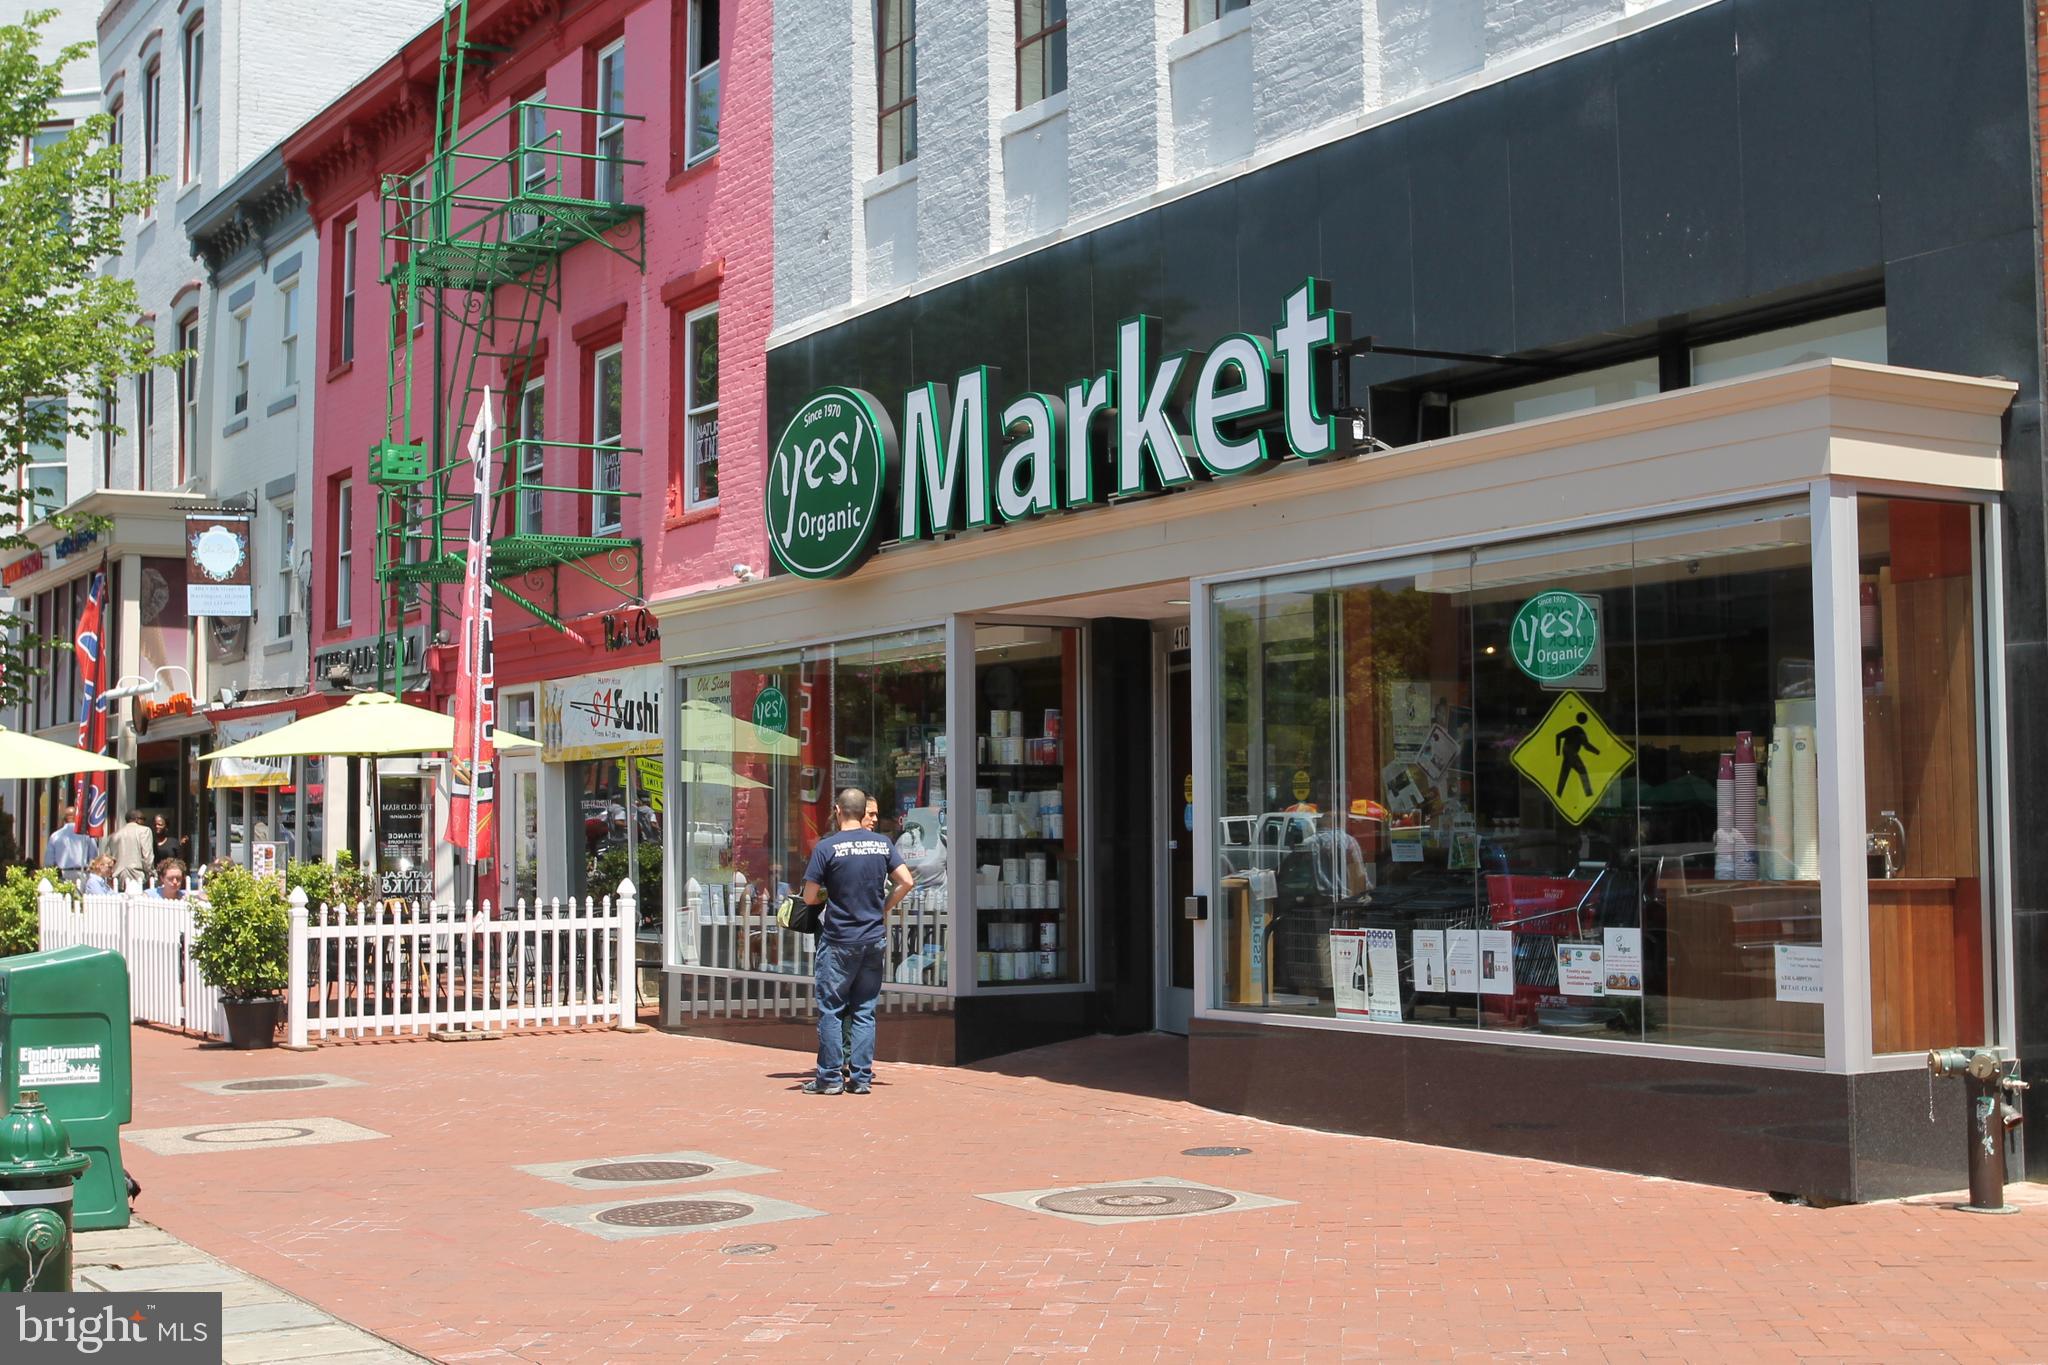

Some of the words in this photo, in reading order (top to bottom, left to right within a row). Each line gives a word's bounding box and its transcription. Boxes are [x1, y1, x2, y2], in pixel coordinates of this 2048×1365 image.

[804, 408, 822, 428] Since
[823, 403, 841, 419] 1970
[899, 276, 1338, 541] Market
[697, 435, 719, 465] KIN
[798, 502, 861, 542] Organic
[1537, 598, 1552, 608] Since
[1552, 596, 1567, 605] 1970
[1174, 626, 1189, 649] 410
[1537, 646, 1584, 665] Organic
[613, 688, 659, 734] Sushi
[832, 841, 855, 850] THINK
[834, 849, 850, 858] ACT
[851, 847, 890, 856] PRACTICALLY
[19, 1044, 101, 1062] Employment
[29, 1060, 67, 1074] Guide
